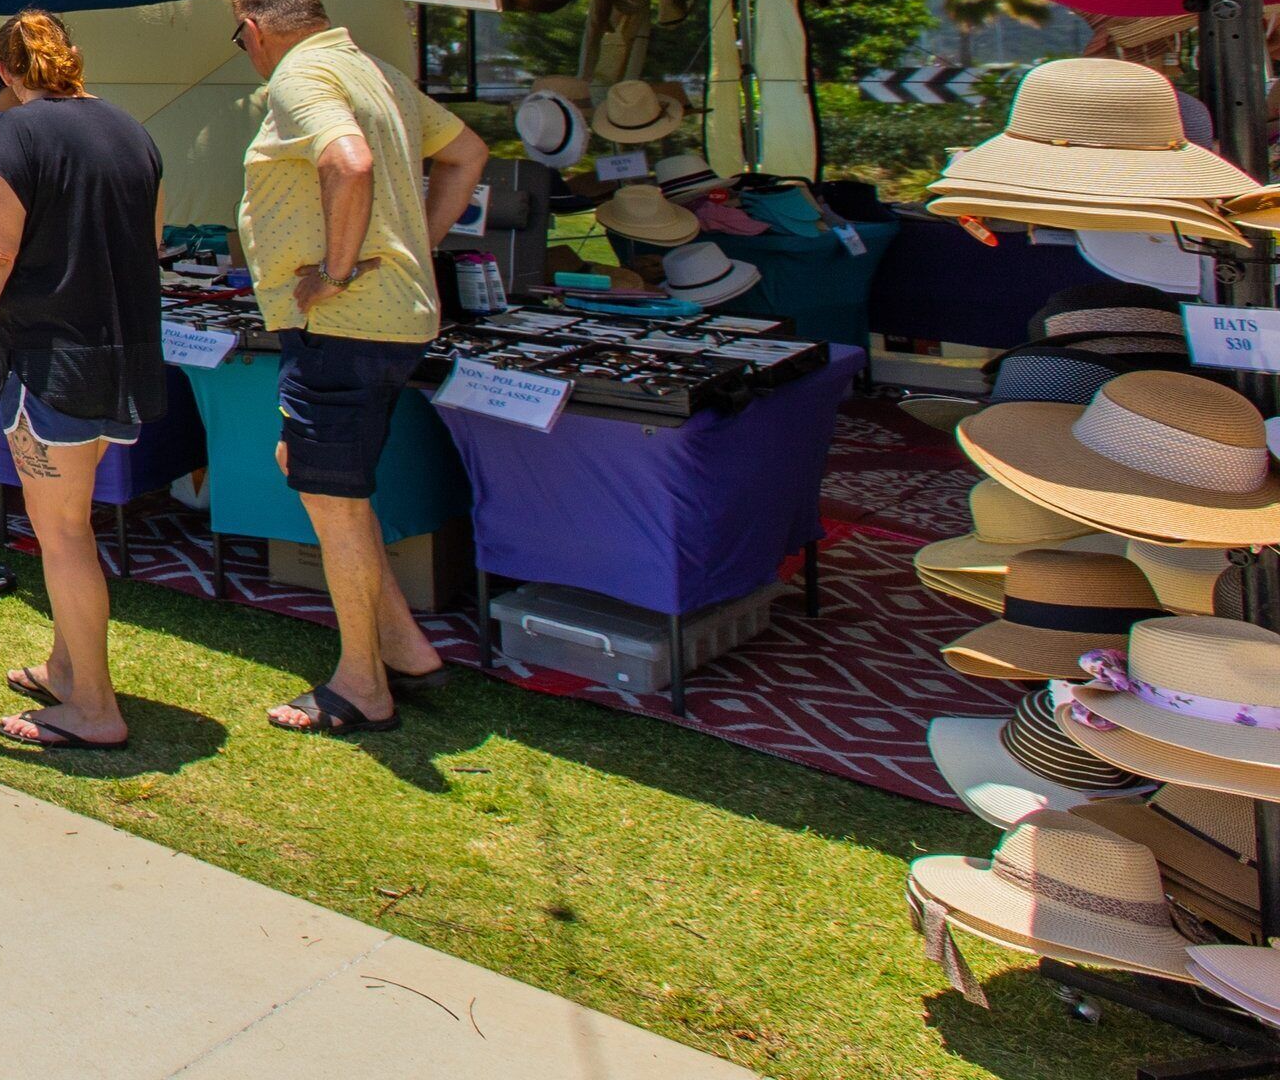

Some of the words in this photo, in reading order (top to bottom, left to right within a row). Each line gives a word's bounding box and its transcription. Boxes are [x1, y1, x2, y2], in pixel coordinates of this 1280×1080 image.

[1213, 317, 1258, 332] HATS
[165, 328, 217, 345] POLARIZED
[1225, 337, 1252, 350] $30
[162, 338, 214, 353] UNGLASSES
[460, 367, 485, 379] NON
[492, 375, 561, 397] POLARIZED
[465, 381, 542, 403] SUNGLASSES
[487, 399, 507, 408] $35
